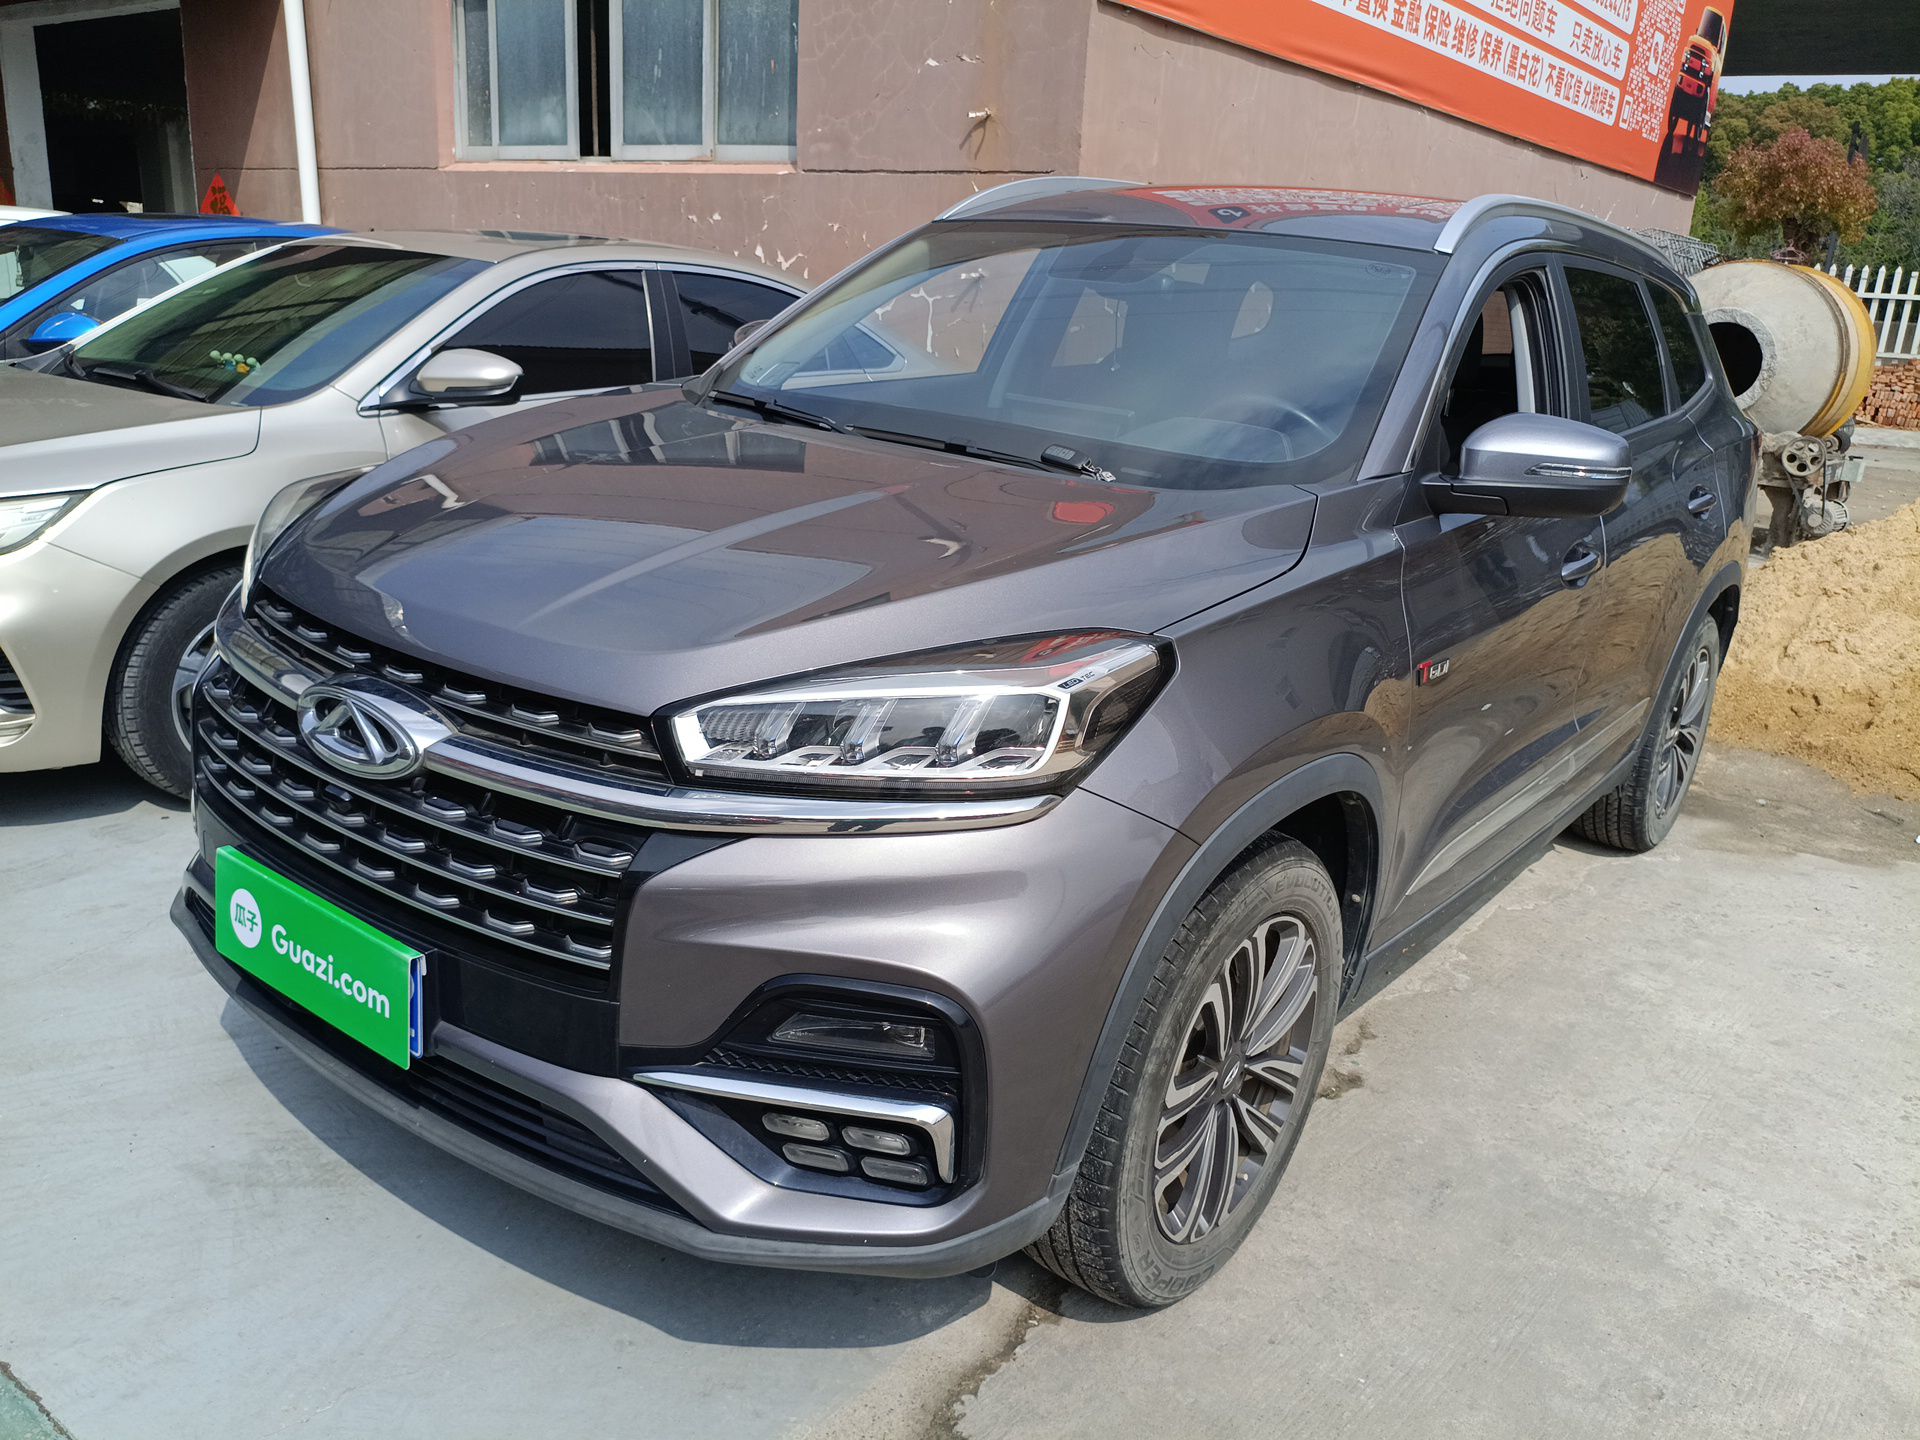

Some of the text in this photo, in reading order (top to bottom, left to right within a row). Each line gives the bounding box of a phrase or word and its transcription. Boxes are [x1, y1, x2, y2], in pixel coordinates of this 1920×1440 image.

[1490, 0, 1623, 72] 绝问题车 只卖放心车
[234, 902, 259, 933] 瓜子
[271, 924, 390, 1019] Guazi.com
